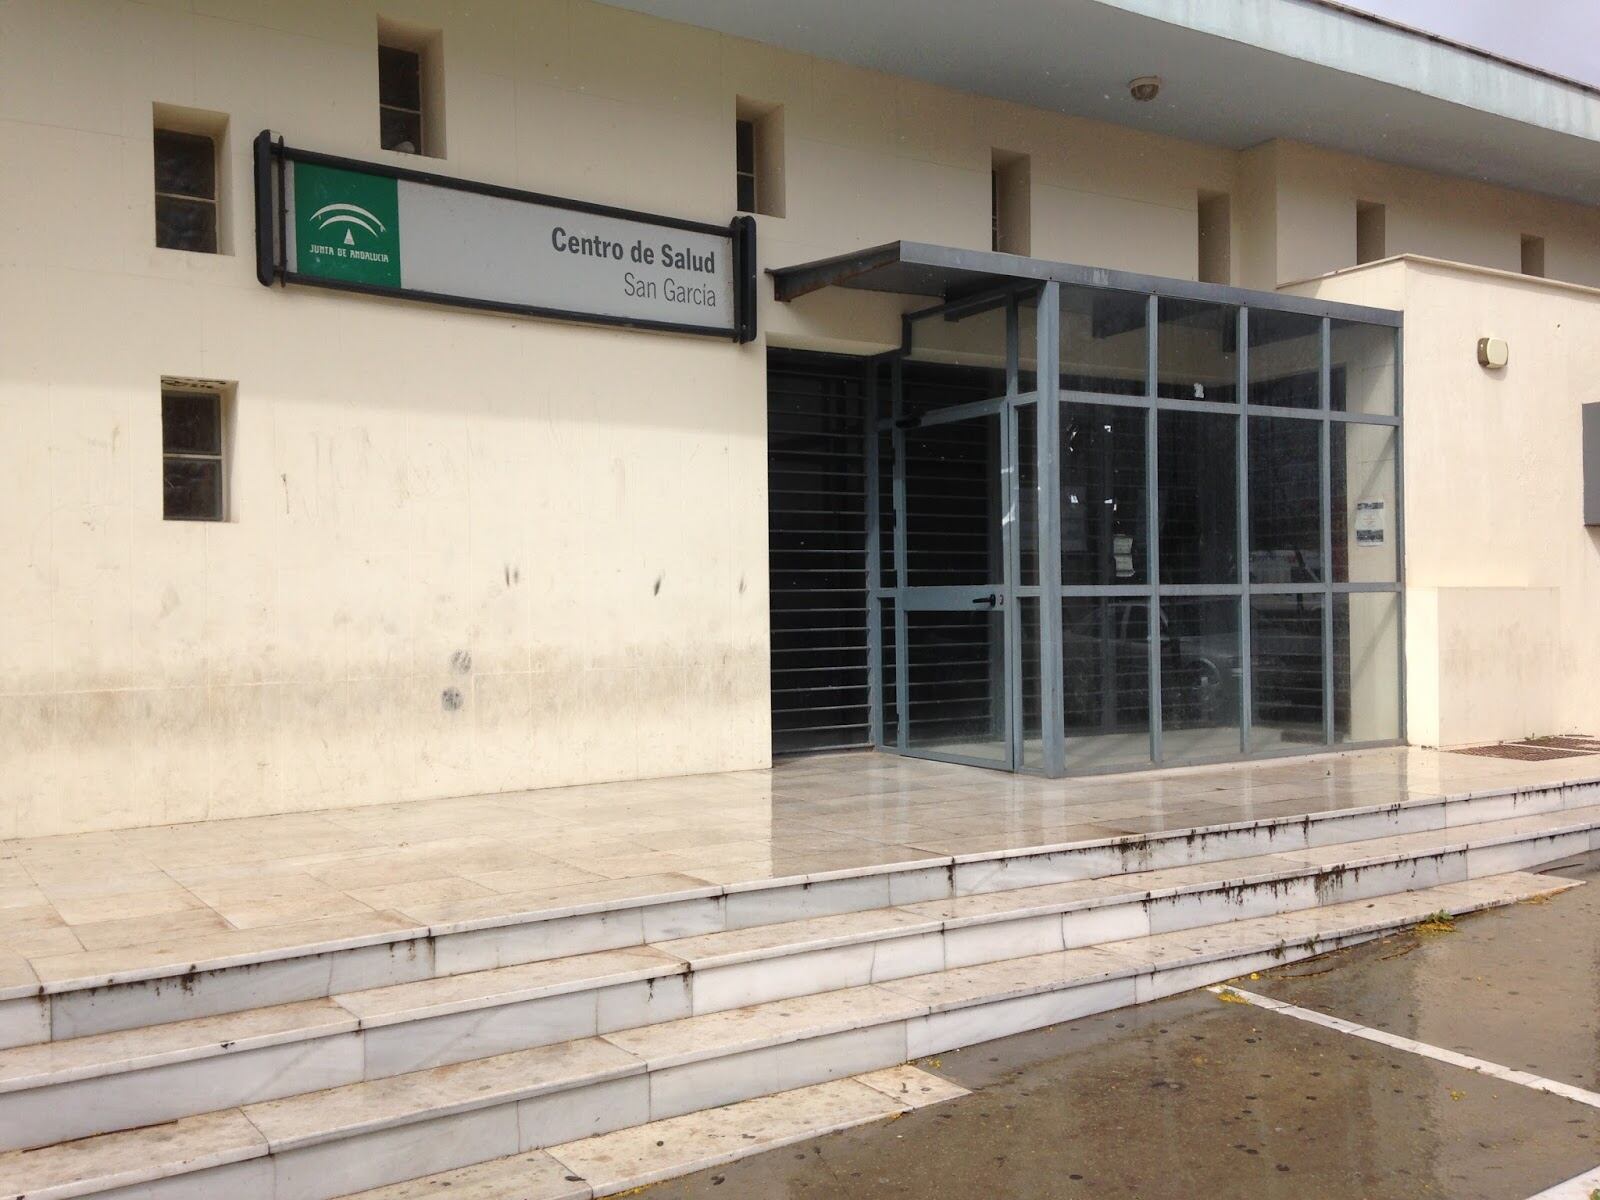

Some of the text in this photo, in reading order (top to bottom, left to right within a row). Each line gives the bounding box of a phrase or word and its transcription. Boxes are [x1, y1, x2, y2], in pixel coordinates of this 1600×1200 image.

[310, 244, 389, 263] JUNTA DE ANDALUCIA
[552, 227, 715, 274] Centro de Salud
[624, 272, 656, 299] San
